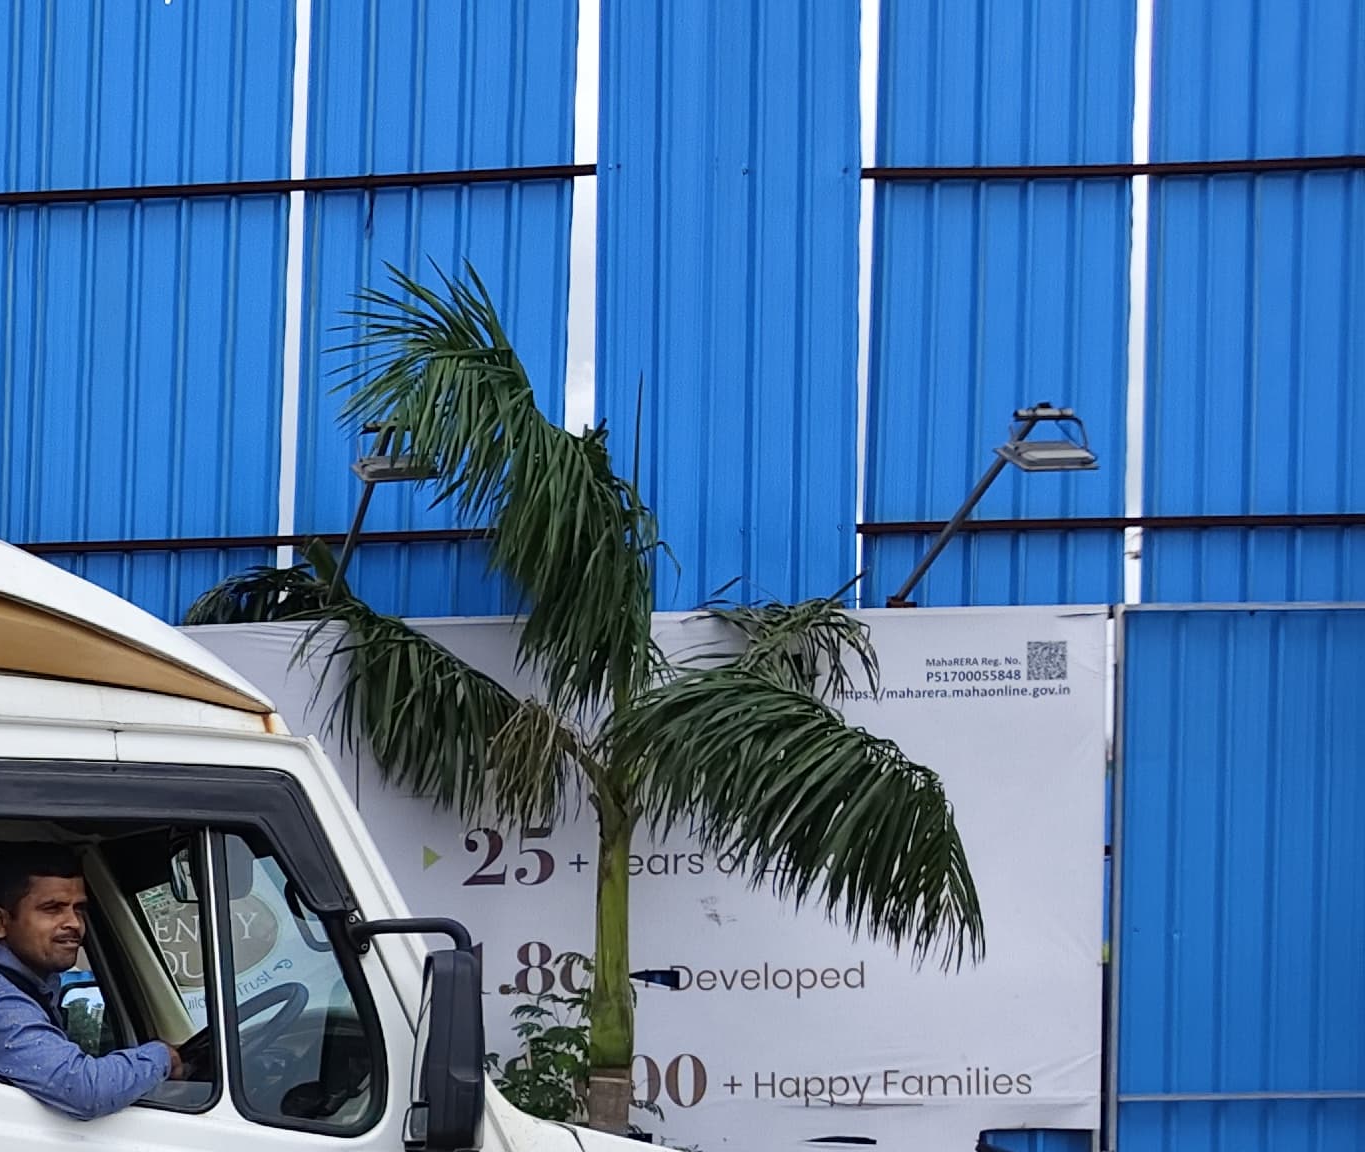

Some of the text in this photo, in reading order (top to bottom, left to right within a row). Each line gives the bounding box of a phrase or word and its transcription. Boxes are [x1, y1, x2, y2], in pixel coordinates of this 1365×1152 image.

[925, 655, 1022, 668] MahaRERA Reg. No.
[925, 669, 1022, 683] P51700055848
[462, 827, 557, 886] 25
[628, 851, 705, 876] ears
[670, 960, 866, 999] Developed
[754, 1071, 873, 1107] Happy
[882, 1066, 1033, 1096] Families
